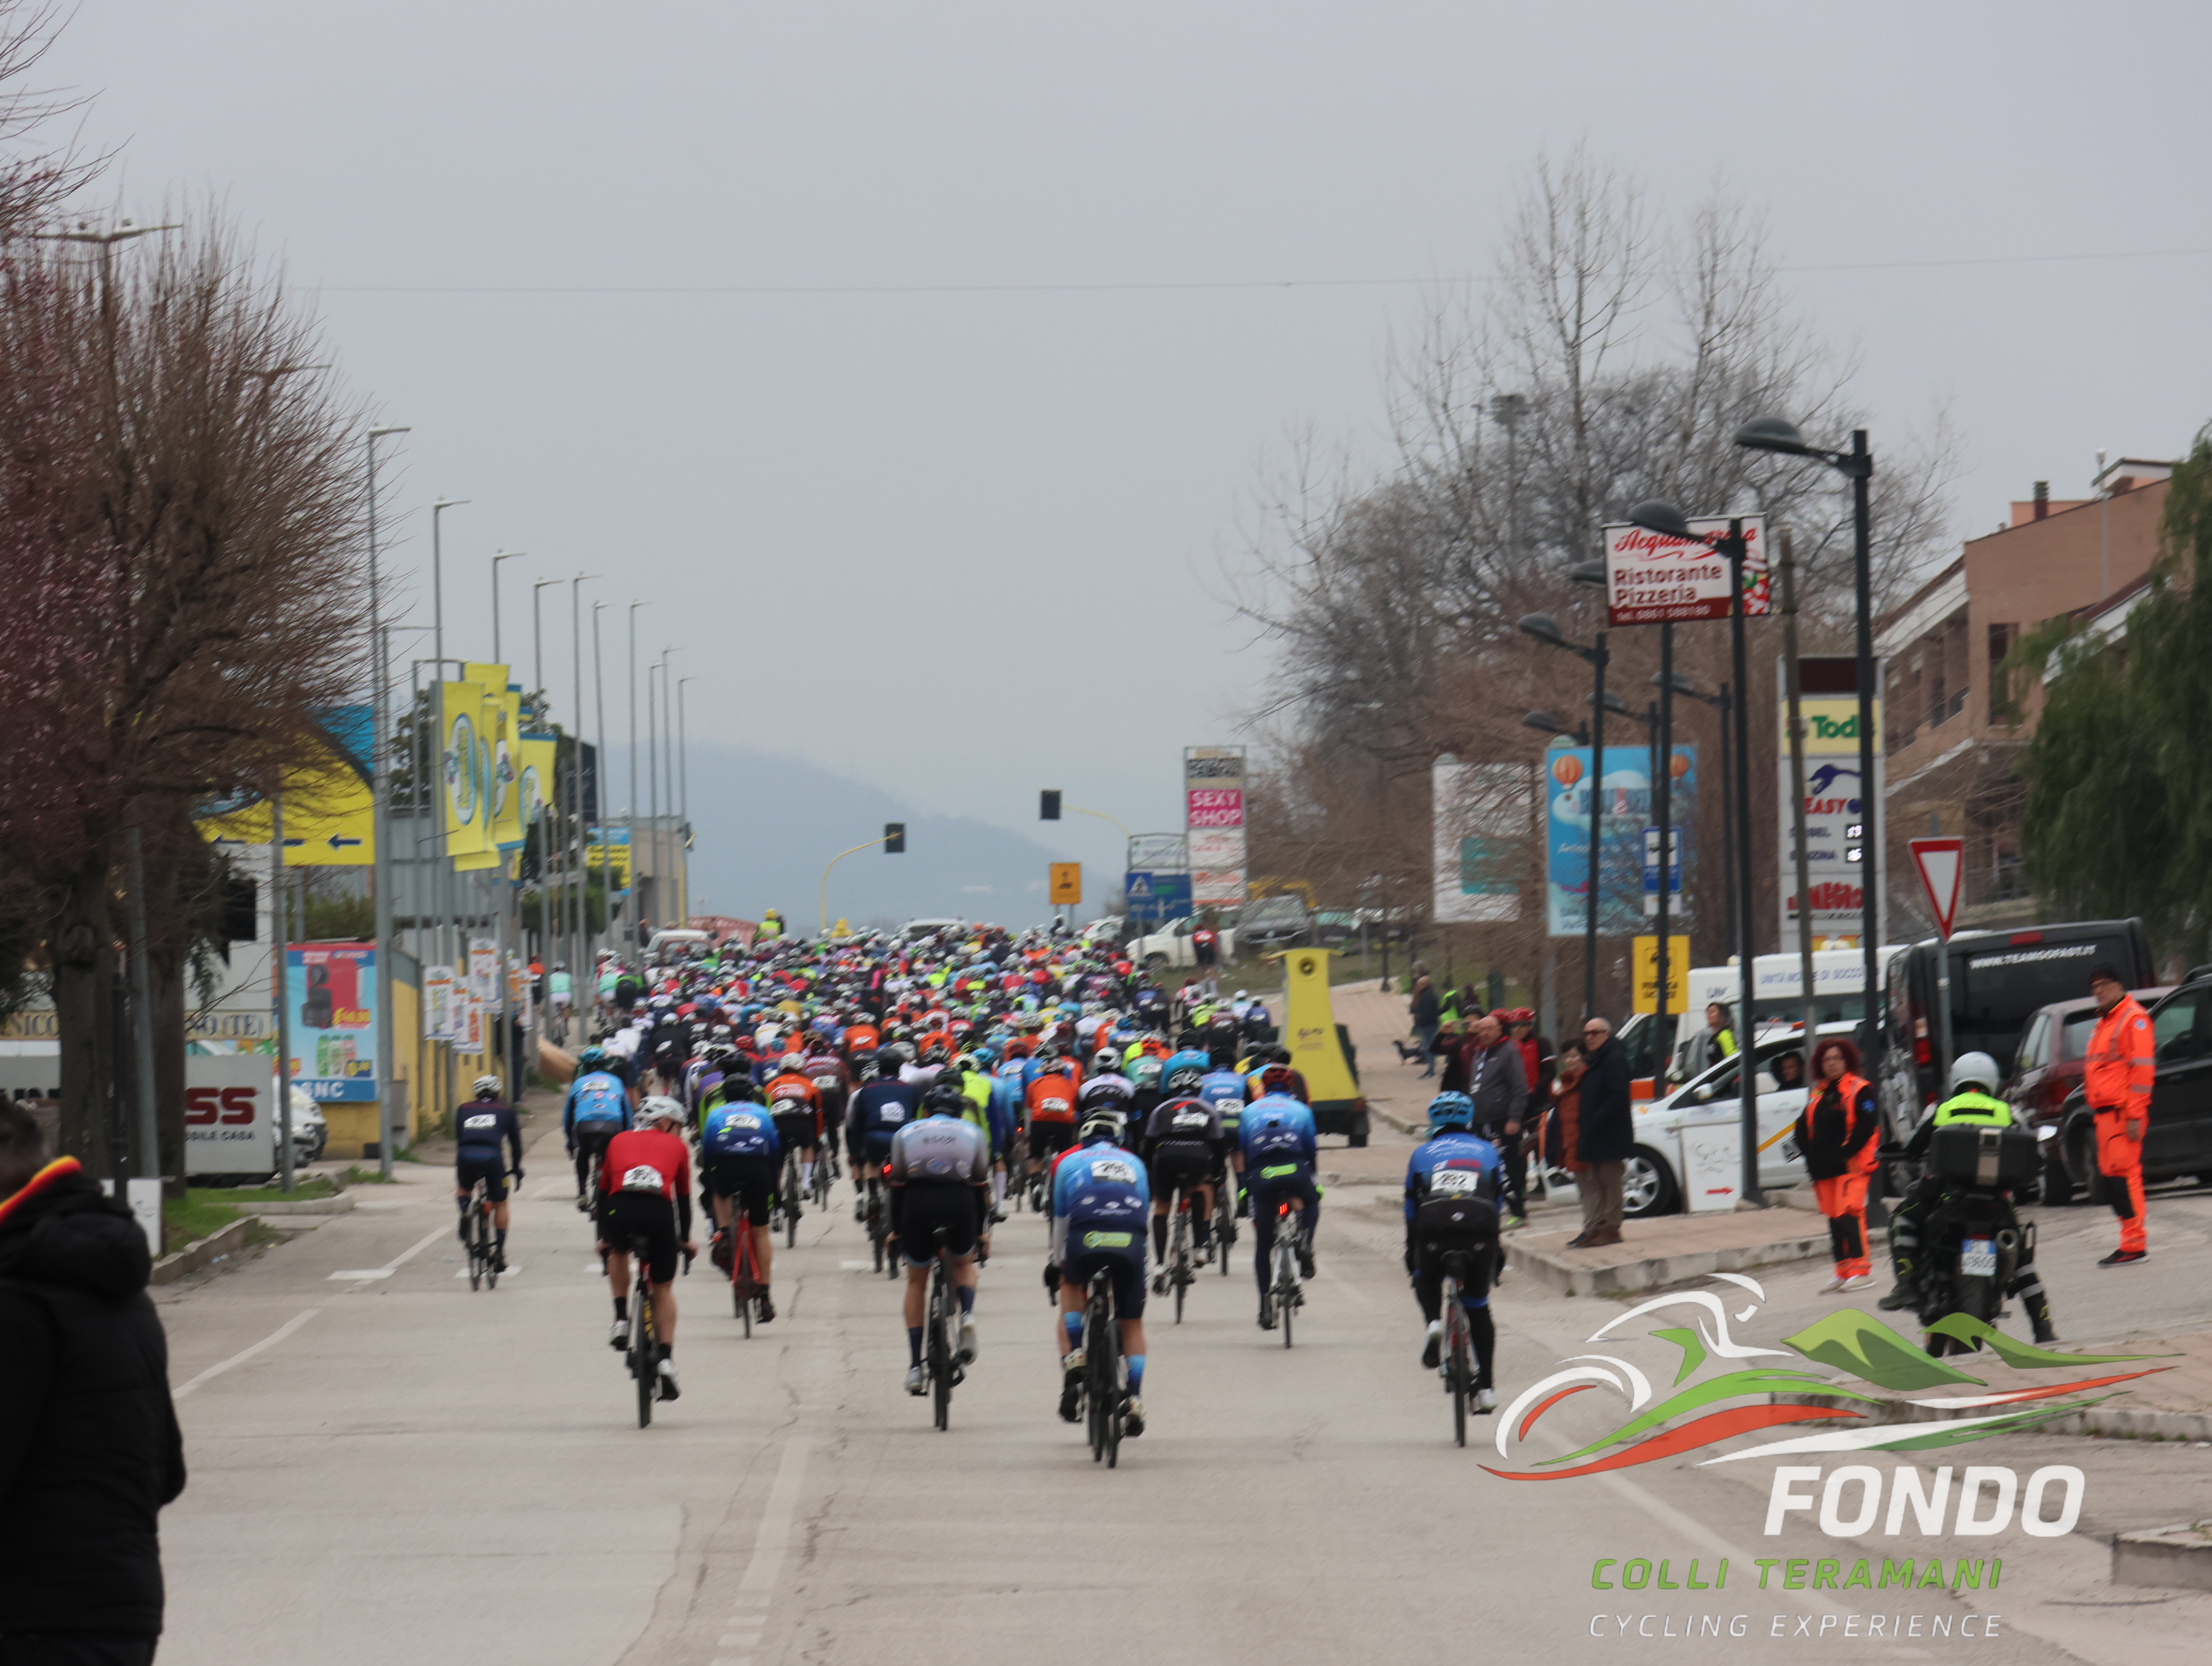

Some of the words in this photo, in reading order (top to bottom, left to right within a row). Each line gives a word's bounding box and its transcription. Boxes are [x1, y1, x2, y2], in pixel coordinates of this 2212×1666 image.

[1614, 563, 1723, 587] Ristorante
[1616, 585, 1697, 605] Pizzeria
[1191, 790, 1238, 808] SEXY
[1189, 809, 1242, 826] SHOP
